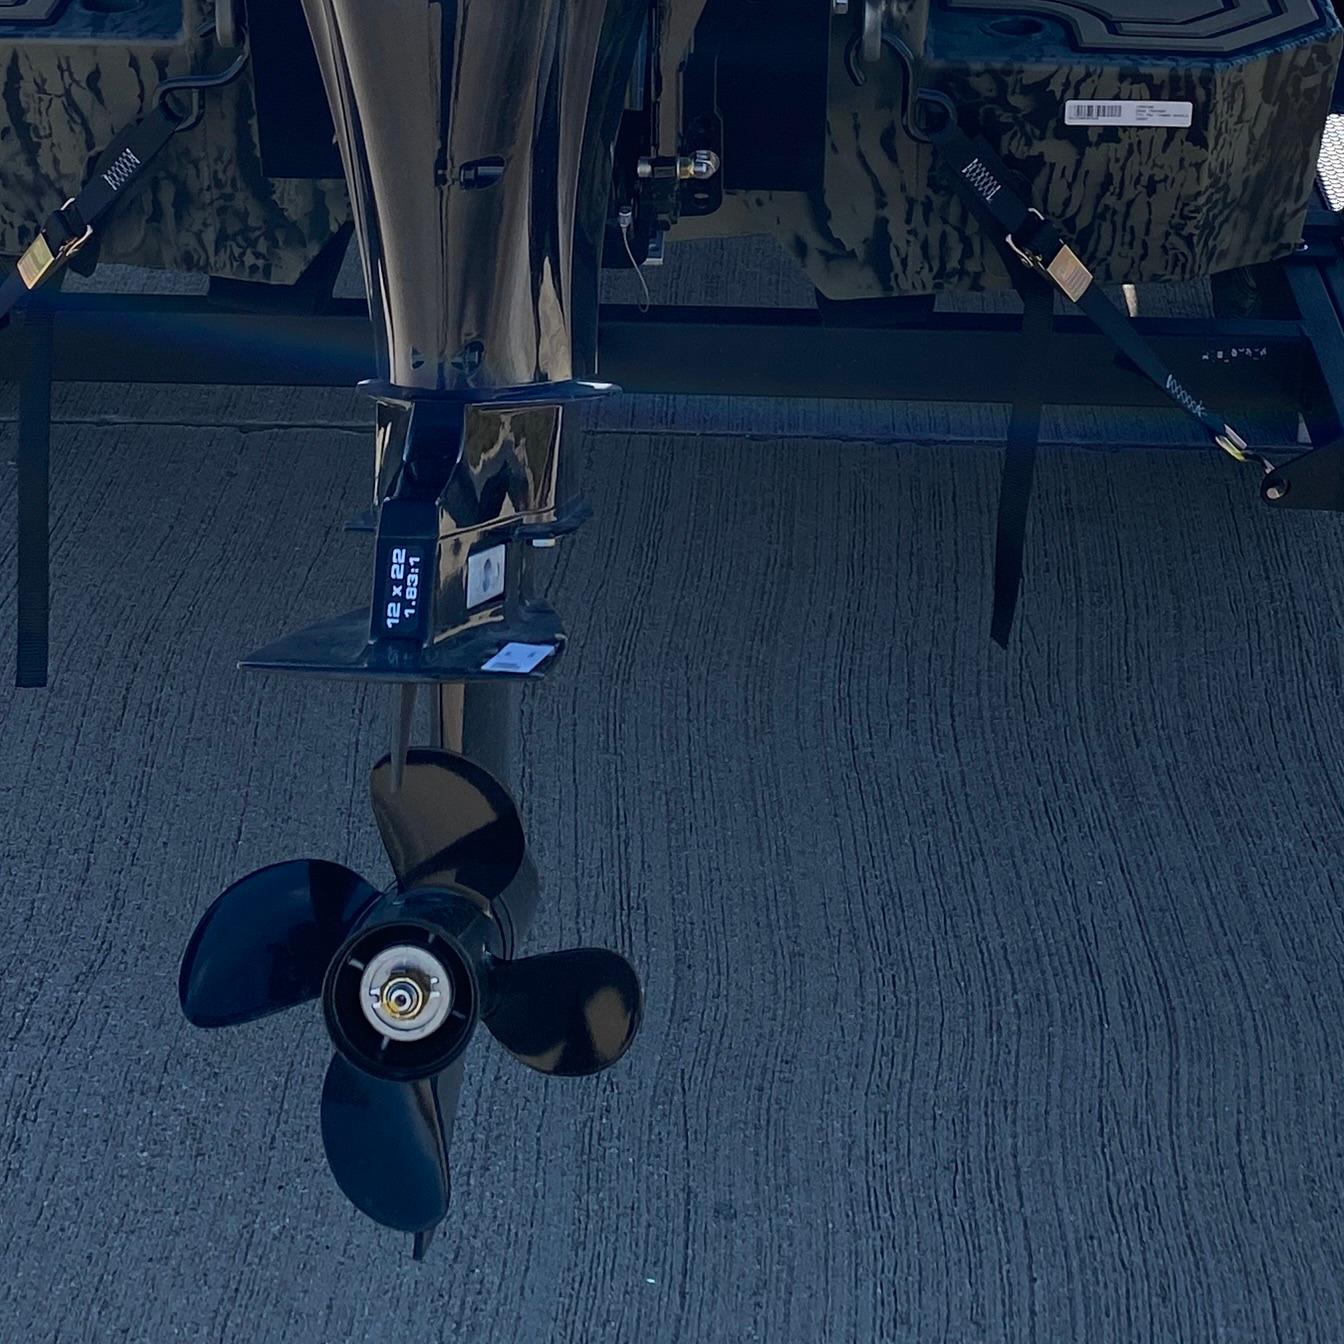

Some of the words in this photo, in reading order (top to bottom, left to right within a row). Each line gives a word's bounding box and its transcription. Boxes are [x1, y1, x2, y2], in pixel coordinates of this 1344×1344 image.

[391, 548, 406, 579] 22
[392, 585, 403, 596] x
[404, 557, 420, 618] 1.83:1
[386, 603, 401, 628] 12
